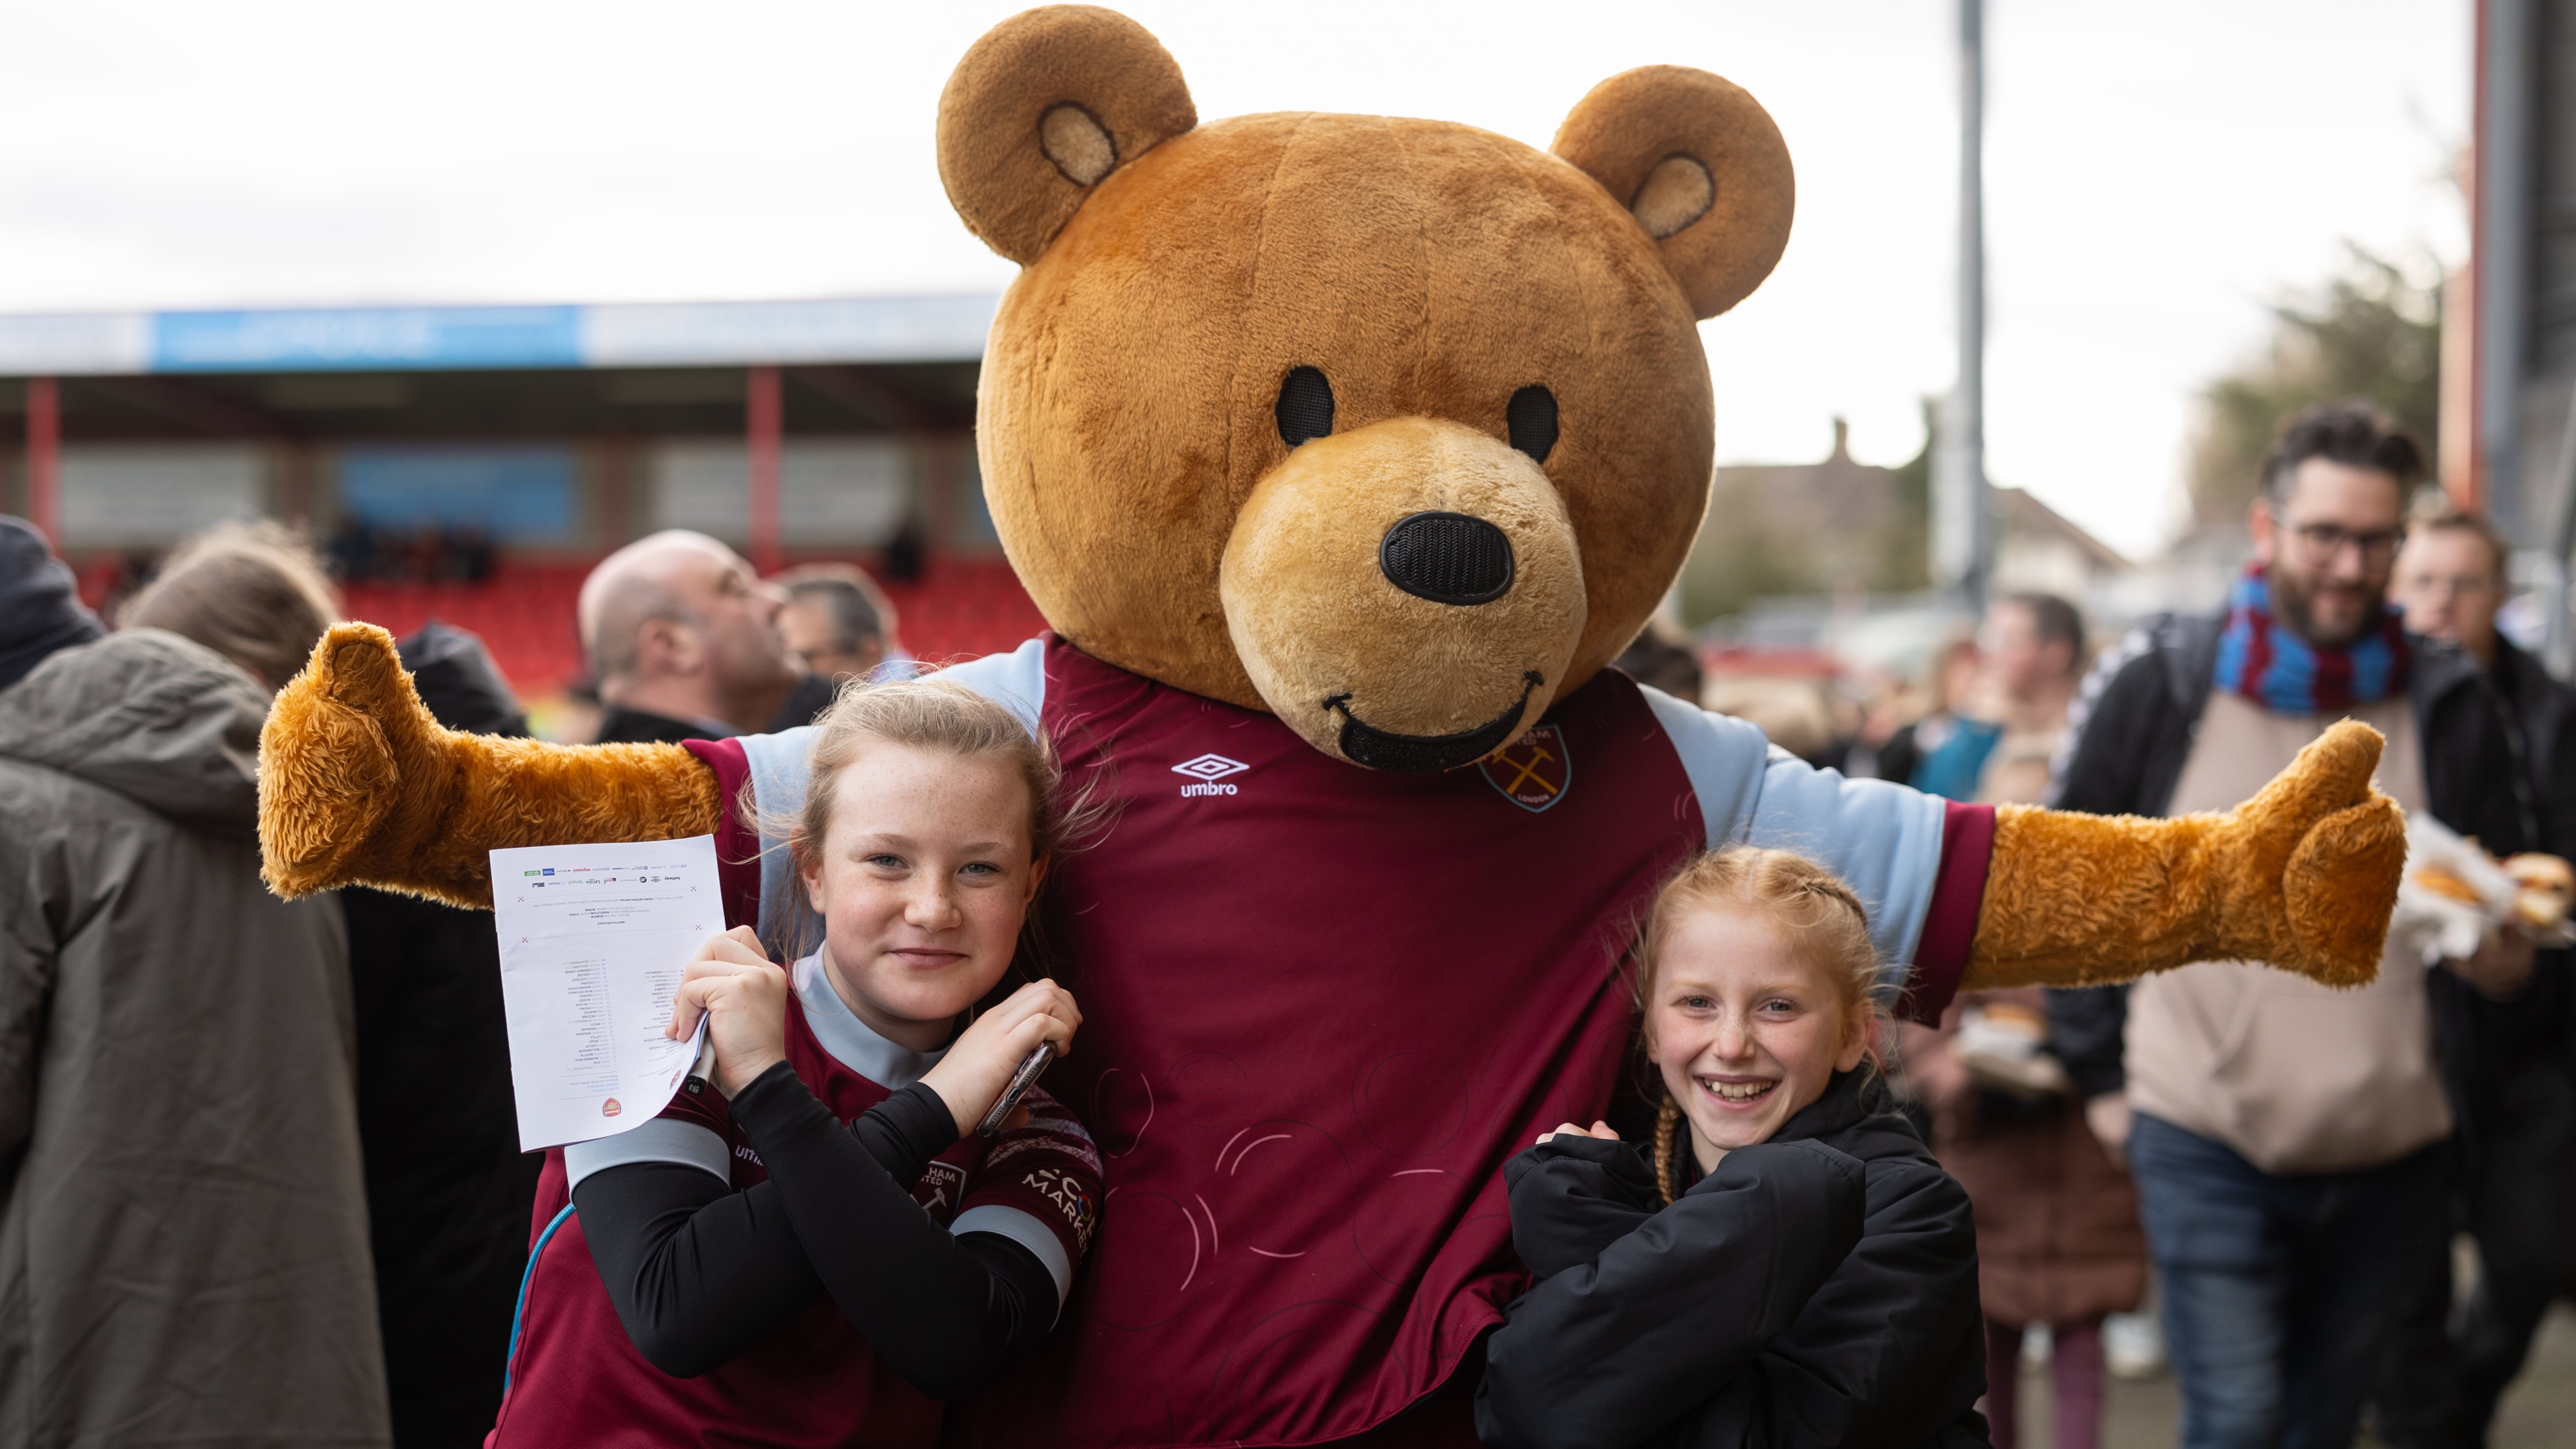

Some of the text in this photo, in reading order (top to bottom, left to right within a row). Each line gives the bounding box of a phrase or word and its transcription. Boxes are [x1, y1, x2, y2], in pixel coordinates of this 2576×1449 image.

[1180, 780, 1238, 797] umbro
[1517, 794, 1550, 803] LONDON
[929, 1167, 956, 1182] HAM
